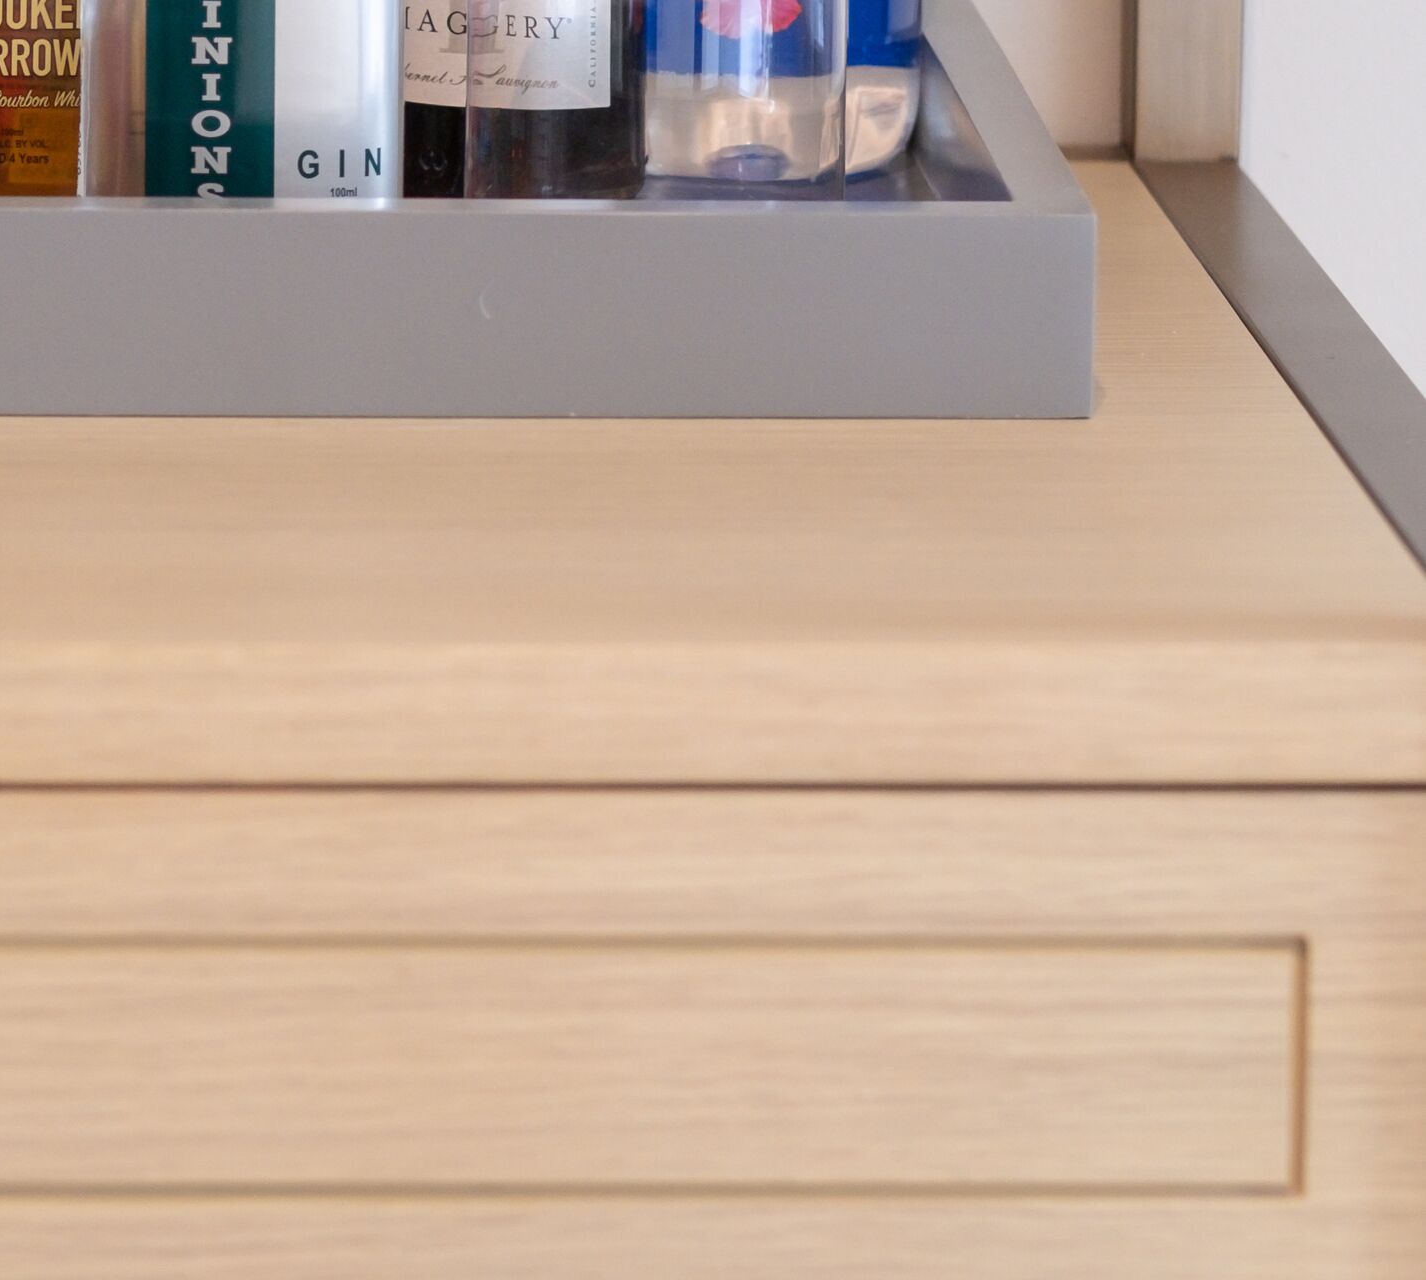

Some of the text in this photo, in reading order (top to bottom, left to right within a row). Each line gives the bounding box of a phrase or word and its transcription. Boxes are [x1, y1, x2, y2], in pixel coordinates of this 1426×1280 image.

[18, 152, 50, 164] Years
[297, 147, 382, 180] GIN
[329, 186, 358, 198] 100ml
